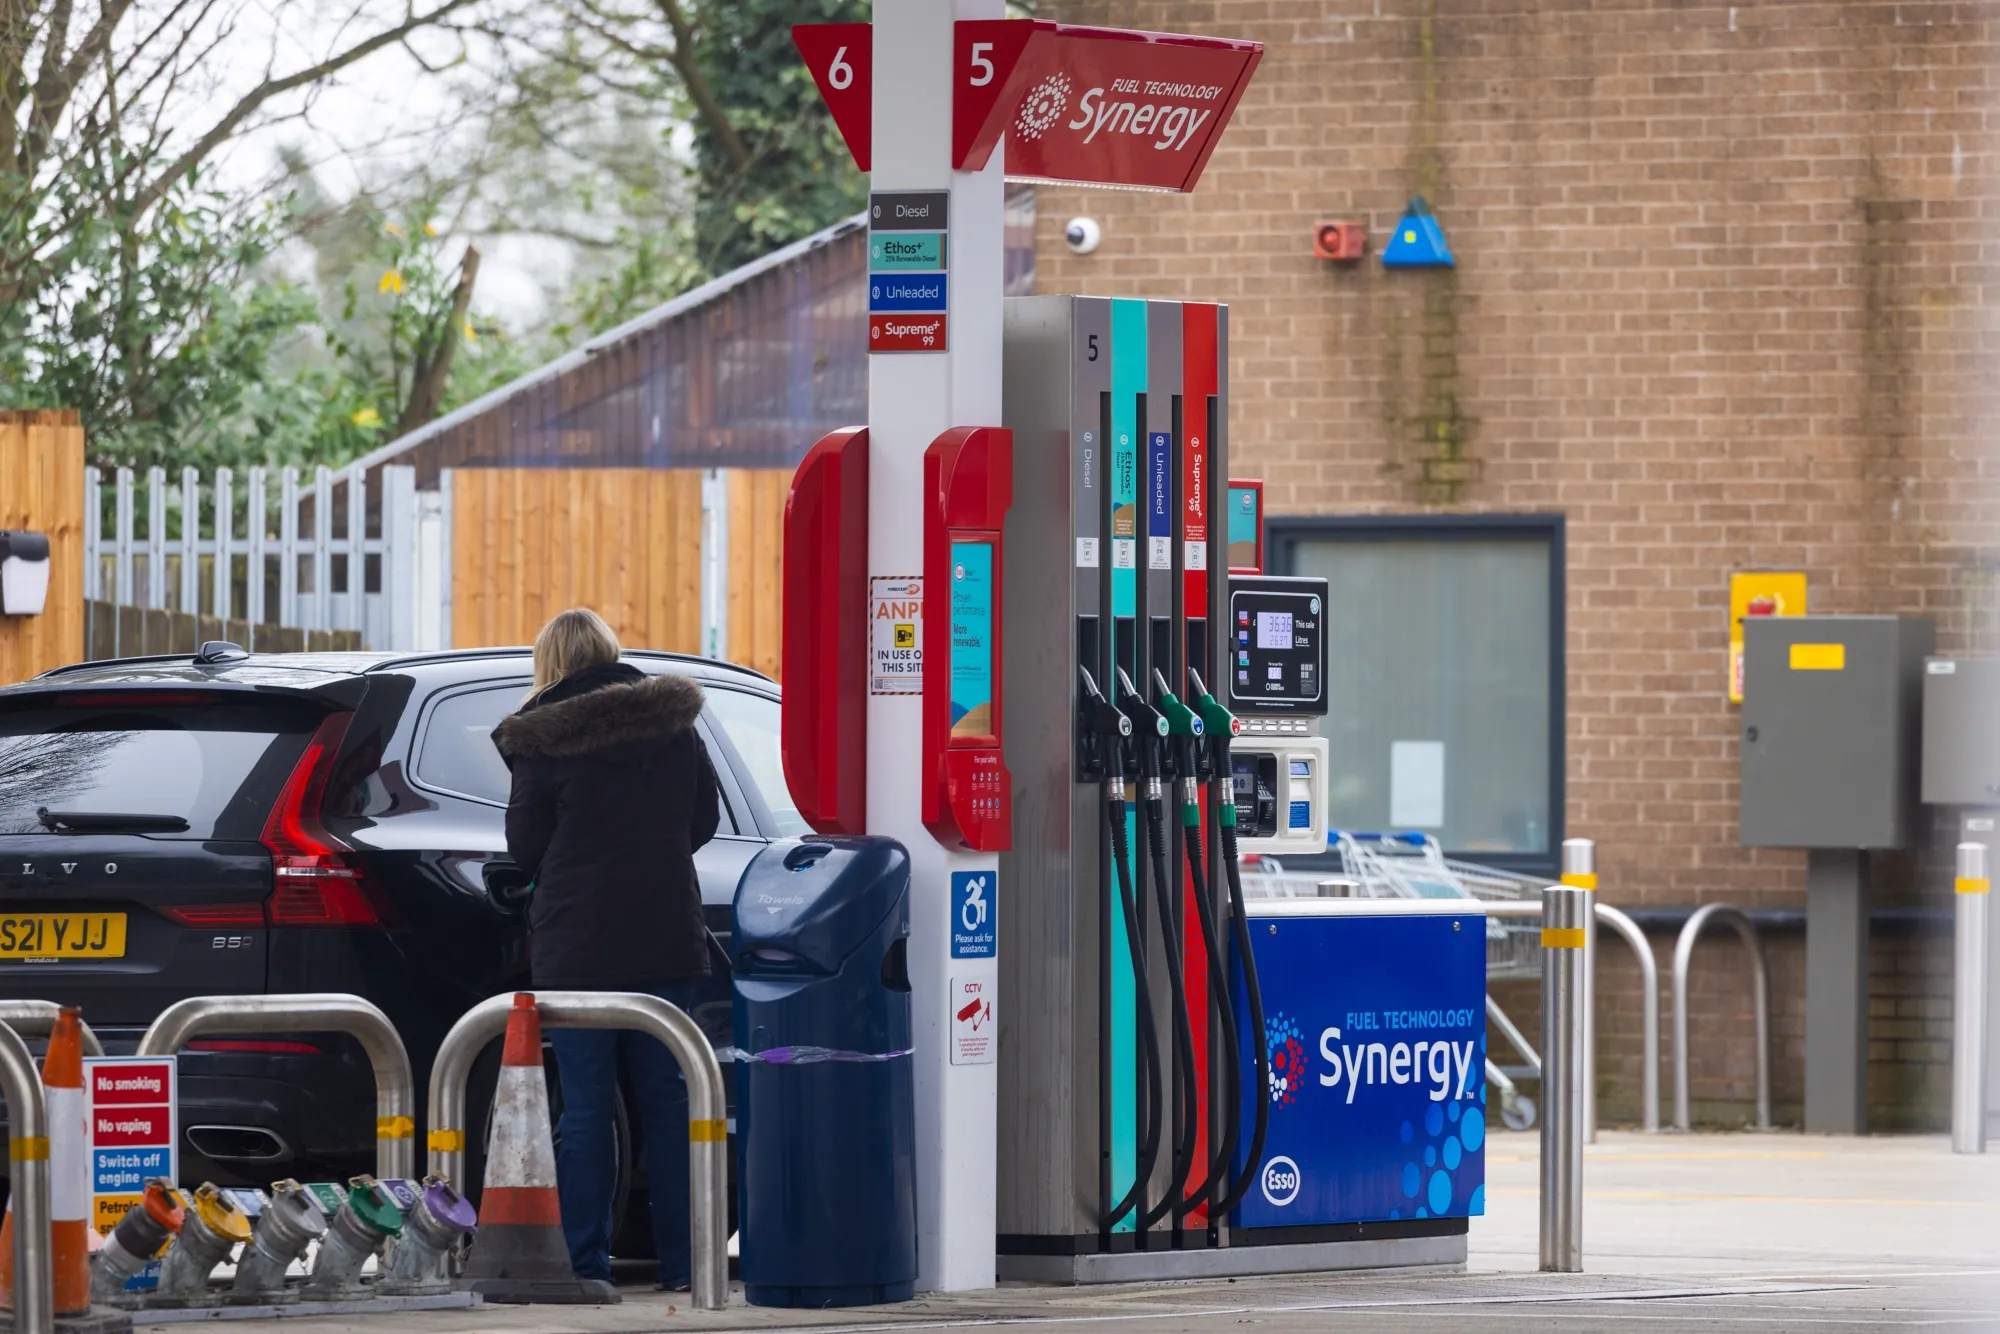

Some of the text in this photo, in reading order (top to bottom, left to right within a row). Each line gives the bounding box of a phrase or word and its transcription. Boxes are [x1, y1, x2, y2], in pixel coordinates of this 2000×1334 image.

[828, 47, 854, 90] 6
[969, 43, 994, 87] 5
[1110, 78, 1223, 100] FUEL TECHNOLOGY
[1068, 87, 1212, 151] Synergy
[896, 204, 929, 218] Diesel
[886, 285, 938, 299] Unleaded
[922, 336, 934, 346] 99
[1088, 334, 1099, 361] 5
[1084, 449, 1092, 488] Diesel
[1156, 453, 1164, 514] Unleaded
[1188, 498, 1194, 511] 99
[1295, 620, 1315, 629] This sale
[1295, 636, 1309, 644] Litres
[877, 650, 922, 660] IN USE O
[882, 662, 904, 673] THIS
[758, 894, 805, 905] Towels
[0, 918, 108, 951] S21 YJJ
[955, 932, 993, 943] Please ask for
[964, 983, 982, 993] CCTV
[1347, 1009, 1474, 1031] FUEL TECHNOLOGY
[1319, 1027, 1475, 1104] Synergy
[97, 1076, 161, 1093] No smoking
[98, 1119, 152, 1135] No vaping
[98, 1153, 160, 1169] Switch off
[98, 1172, 140, 1187] engine
[100, 1200, 139, 1214] Petrol
